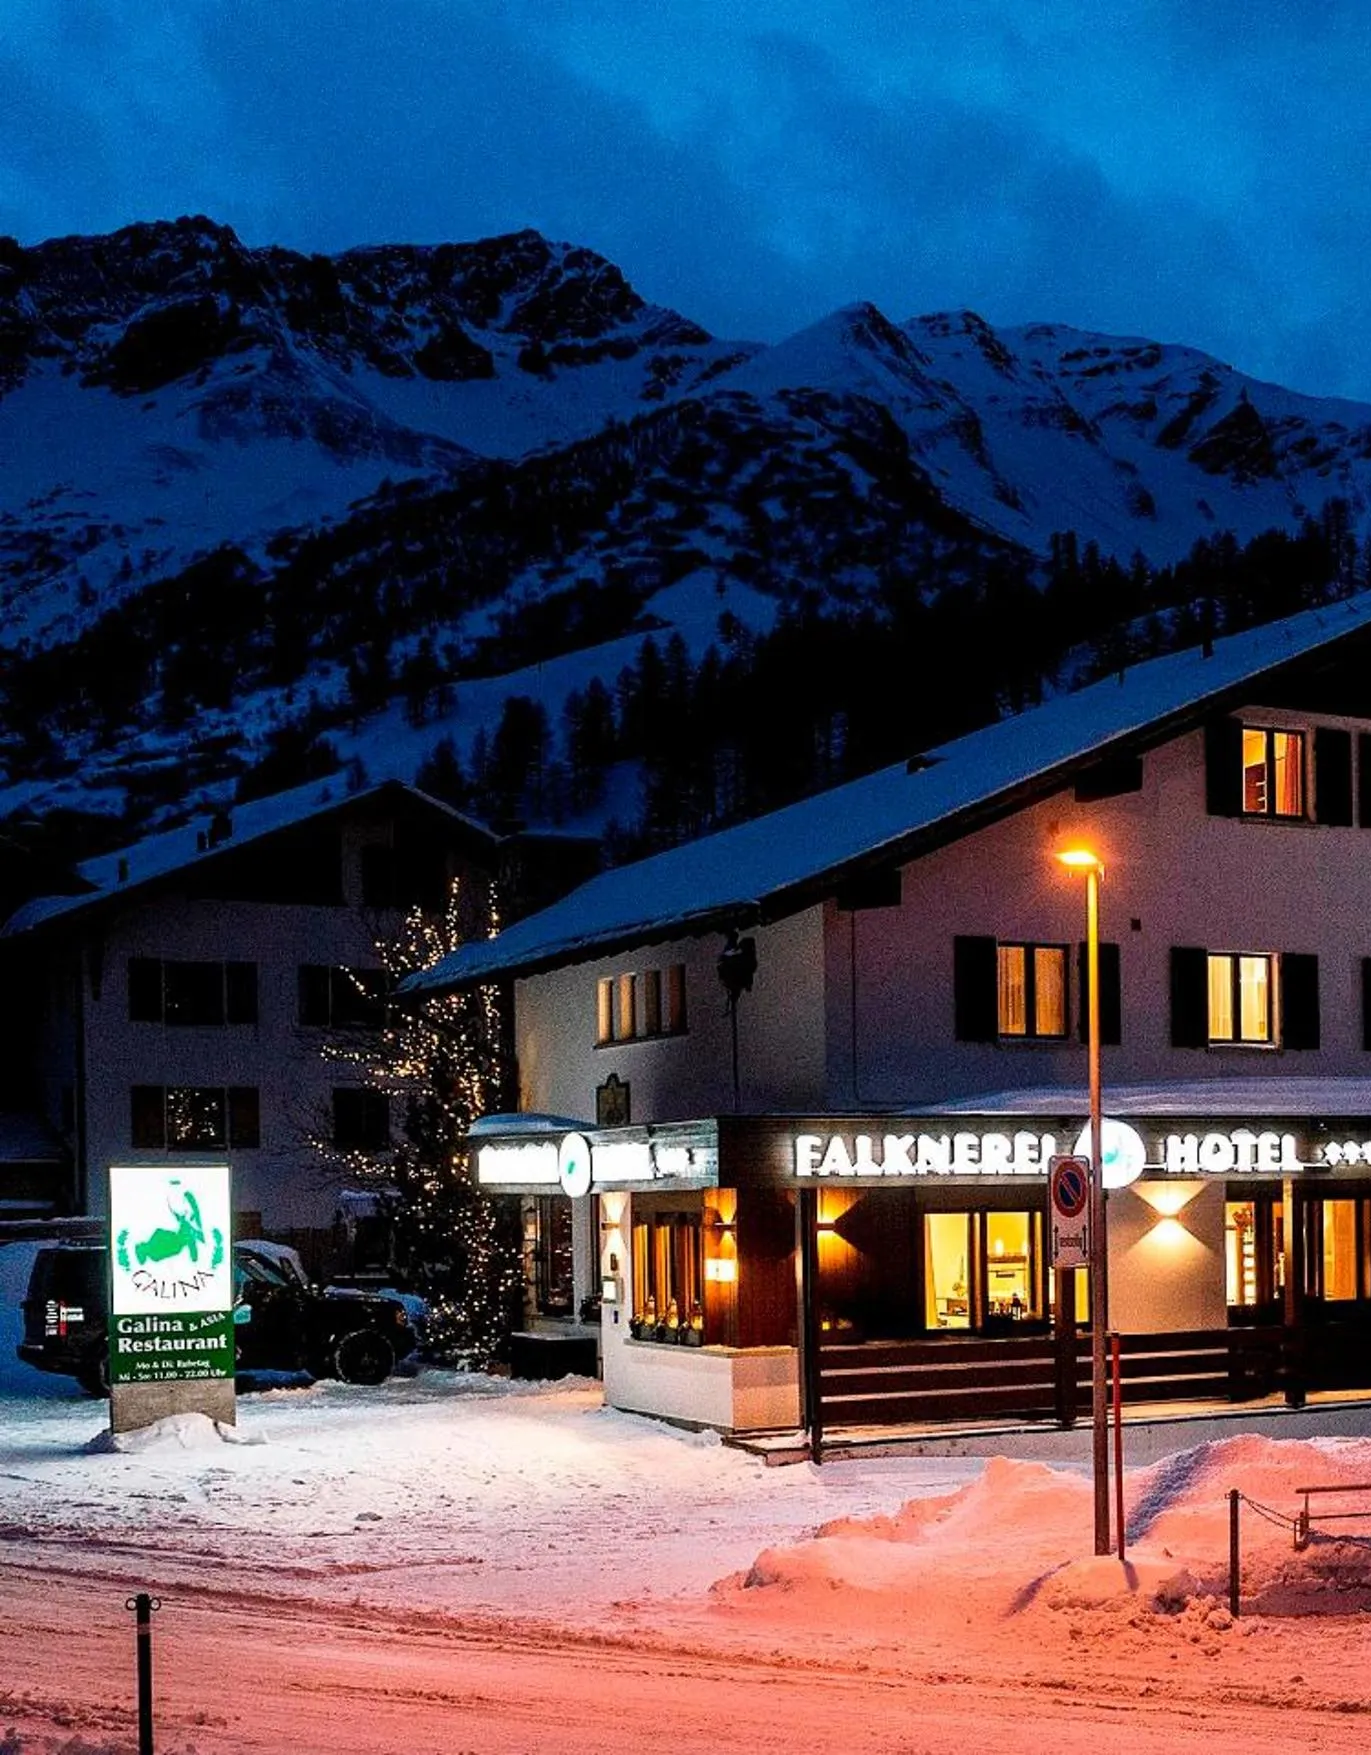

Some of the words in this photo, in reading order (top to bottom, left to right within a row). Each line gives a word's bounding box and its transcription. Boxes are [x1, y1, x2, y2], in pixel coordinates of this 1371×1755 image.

[795, 1131, 1056, 1176] FALKNEREI
[1166, 1128, 1304, 1172] HOTEL
[131, 1269, 215, 1299] GALINA
[117, 1316, 184, 1334] Galina
[200, 1312, 226, 1328] ASIA
[118, 1334, 227, 1353] Restaurant
